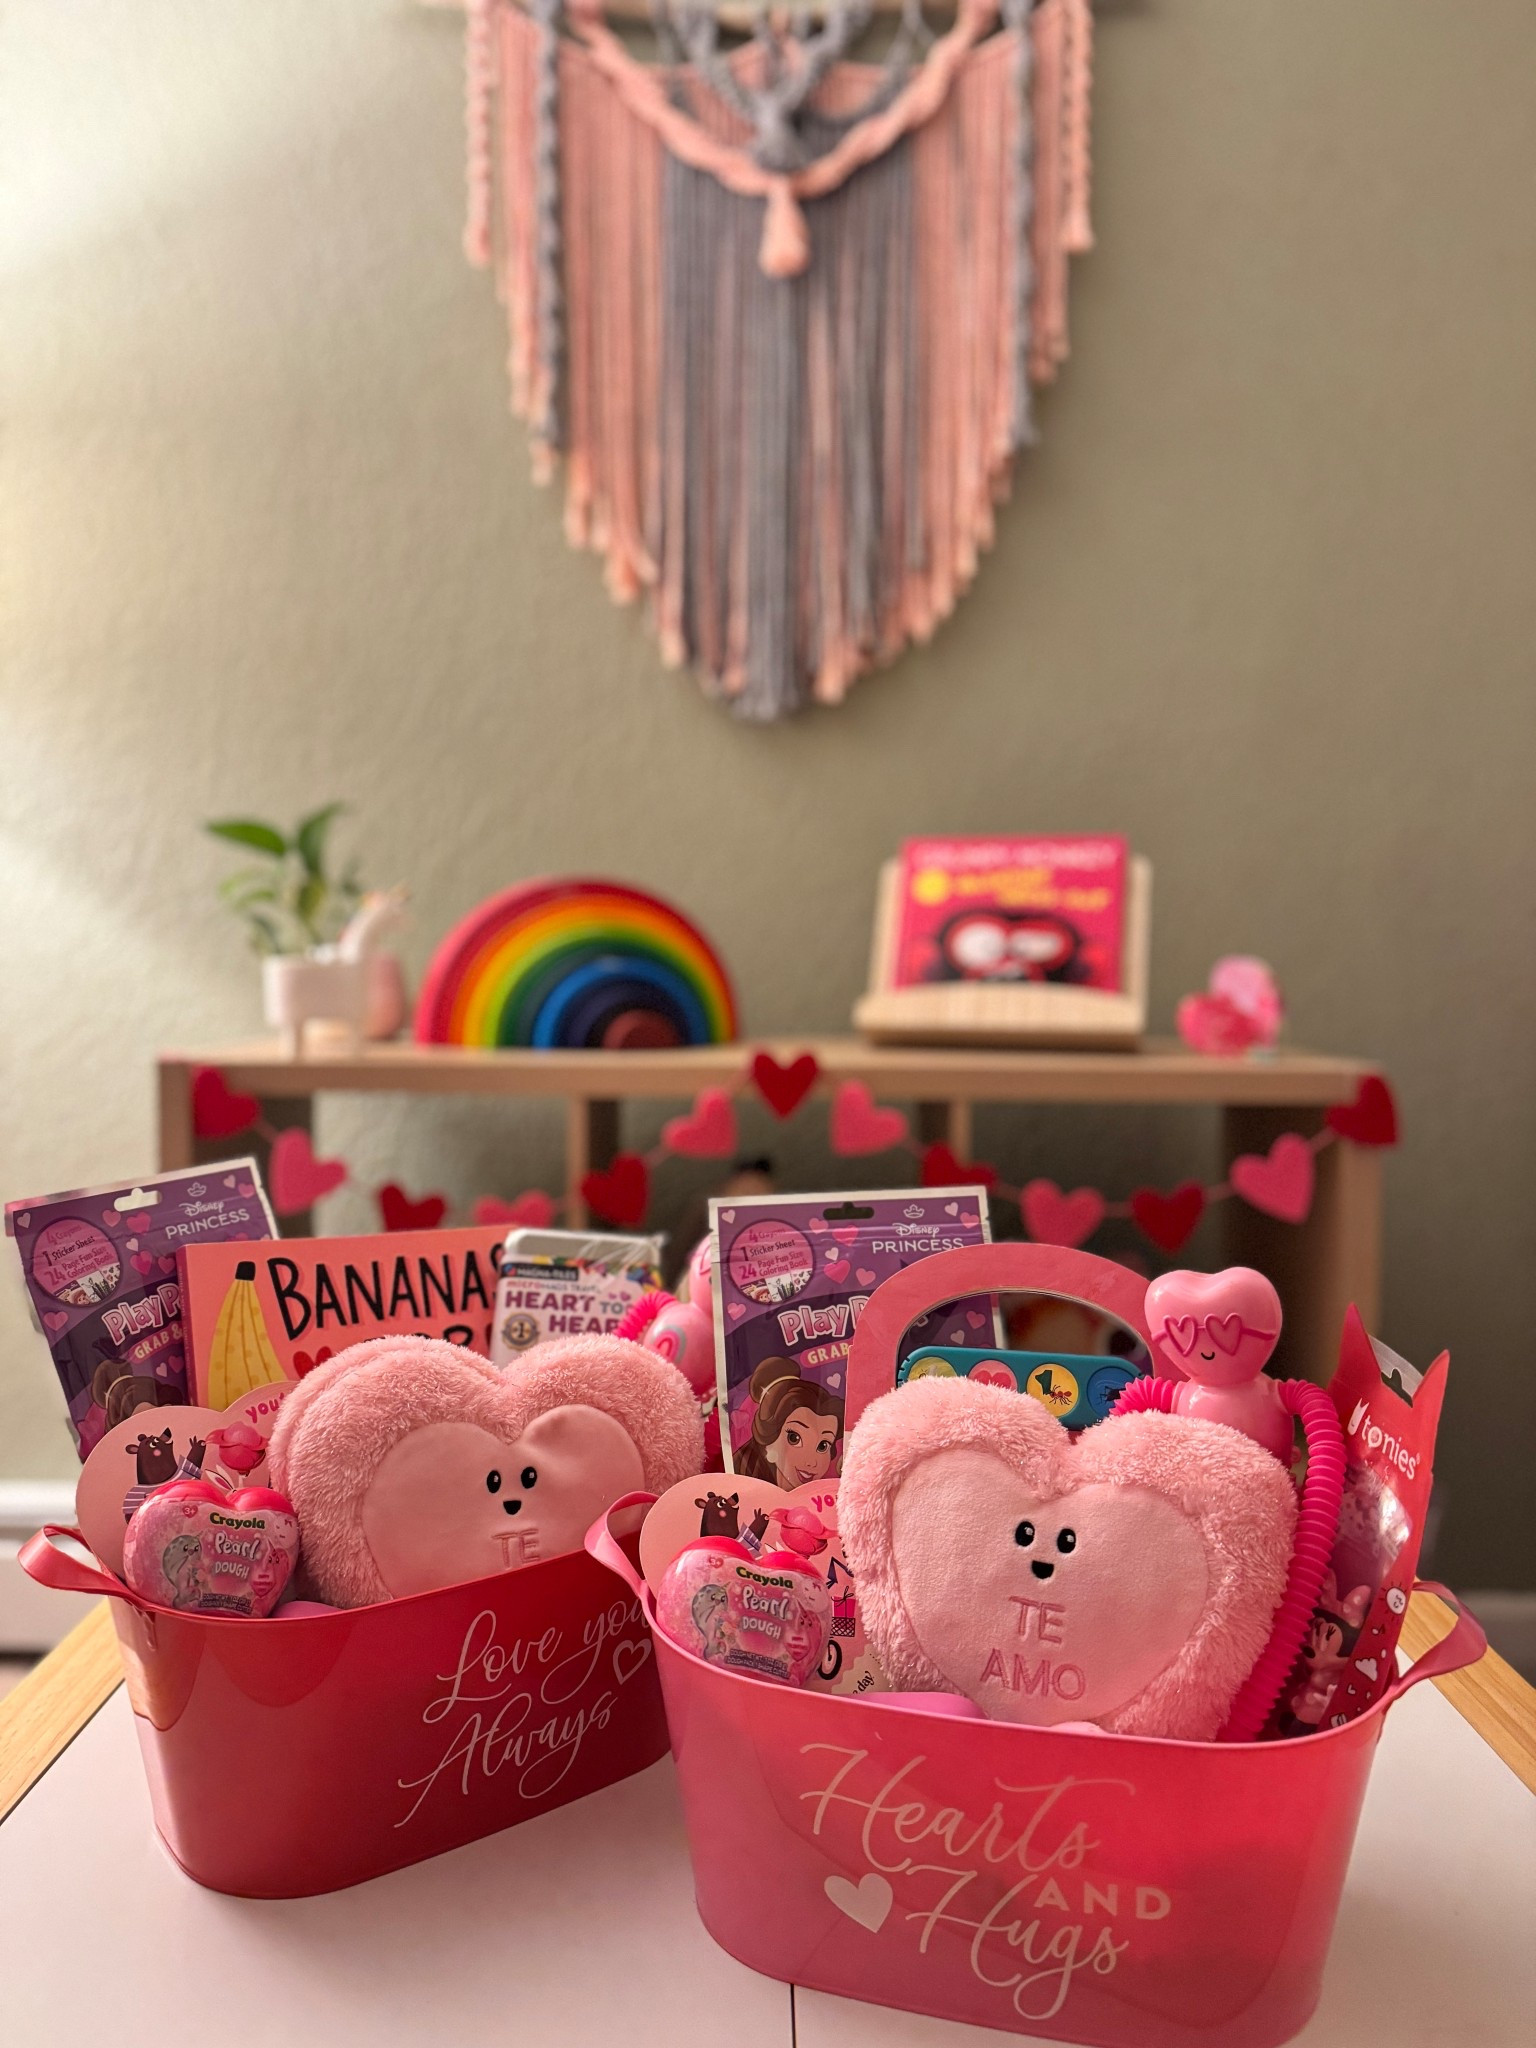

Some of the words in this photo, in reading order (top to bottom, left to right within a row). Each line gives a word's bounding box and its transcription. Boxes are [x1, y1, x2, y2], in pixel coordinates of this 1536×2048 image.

[165, 1208, 250, 1240] PRINCESS
[178, 1201, 225, 1217] Disney
[892, 1222, 940, 1238] Disney
[42, 1250, 53, 1267] 1
[52, 1244, 76, 1261] Sticker
[75, 1235, 96, 1250] Sheet
[740, 1246, 749, 1262] 1
[750, 1244, 775, 1258] Sticker
[774, 1239, 796, 1250] Sheet
[872, 1238, 964, 1254] PRINCESS
[43, 1267, 67, 1286] 24
[61, 1257, 79, 1271] Page
[79, 1252, 93, 1264] Fun
[66, 1260, 97, 1279] Coloring
[739, 1263, 757, 1280] 24
[757, 1258, 775, 1269] Page
[775, 1255, 789, 1264] Fun
[789, 1251, 804, 1260] Size
[759, 1264, 789, 1277] Coloring
[789, 1258, 808, 1269] Book
[505, 1290, 597, 1313] HEART
[599, 1301, 623, 1316] TO
[101, 1301, 164, 1347] Play
[549, 1315, 620, 1335] HEAR
[777, 1304, 849, 1347] Play
[134, 1330, 170, 1359] GRAB
[171, 1322, 183, 1341] &
[807, 1342, 849, 1364] GRAB
[1361, 1414, 1417, 1480] tonies
[183, 1506, 197, 1516] 3+
[209, 1511, 266, 1530] Crayola
[214, 1531, 261, 1560] Pearl
[491, 1528, 541, 1570] TE
[214, 1561, 250, 1580] DOUGH
[735, 1566, 794, 1589] Crayola
[742, 1584, 790, 1620] Pearl
[742, 1616, 782, 1640] DOUGH
[1008, 1595, 1067, 1645] TE
[422, 1609, 563, 1724] Love
[541, 1597, 651, 1705] you
[979, 1647, 1087, 1701] AMO
[394, 1691, 618, 1829] Always
[799, 1743, 1136, 1873] Hearts
[1034, 1877, 1171, 1921] AND
[905, 1863, 1130, 2021] Hugs
